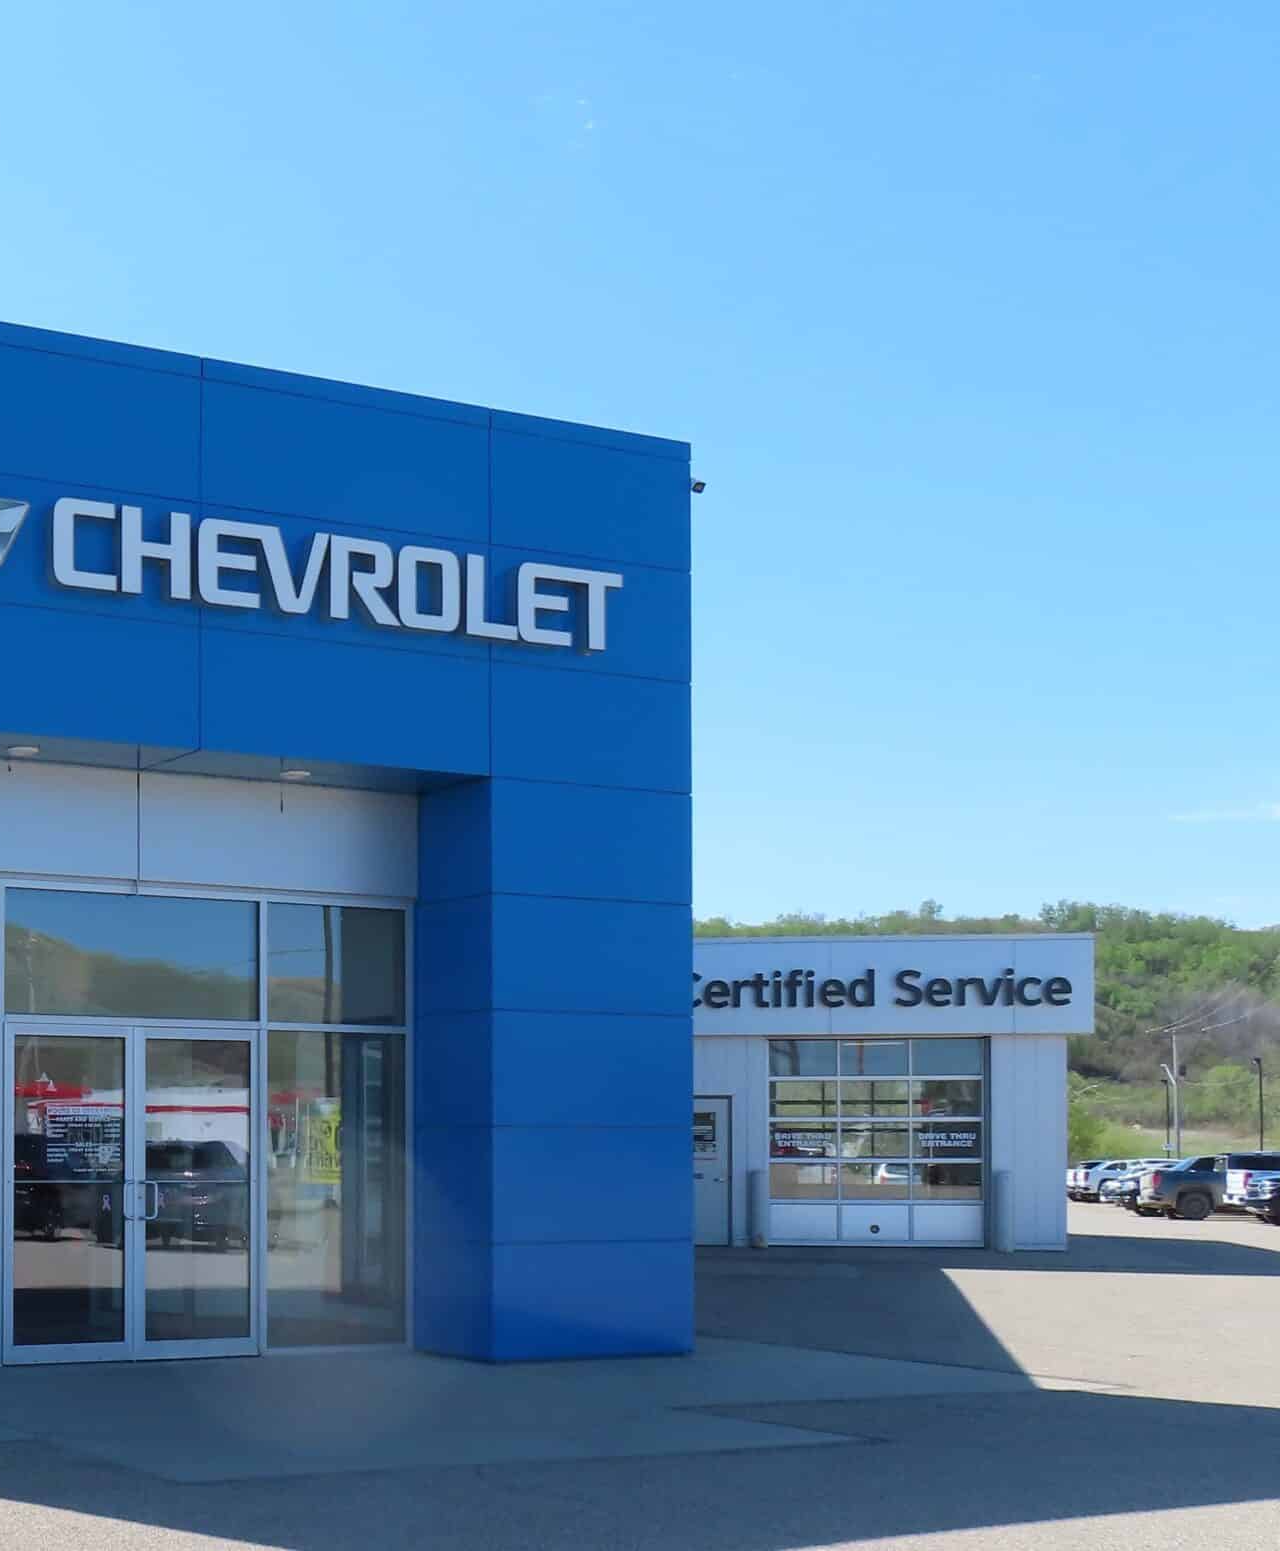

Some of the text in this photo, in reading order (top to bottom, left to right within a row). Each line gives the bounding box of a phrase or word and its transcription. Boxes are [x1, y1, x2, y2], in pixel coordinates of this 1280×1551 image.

[52, 496, 624, 652] CHEVROLET
[893, 967, 1074, 1008] Service
[921, 1140, 973, 1148] ENTRANCE
